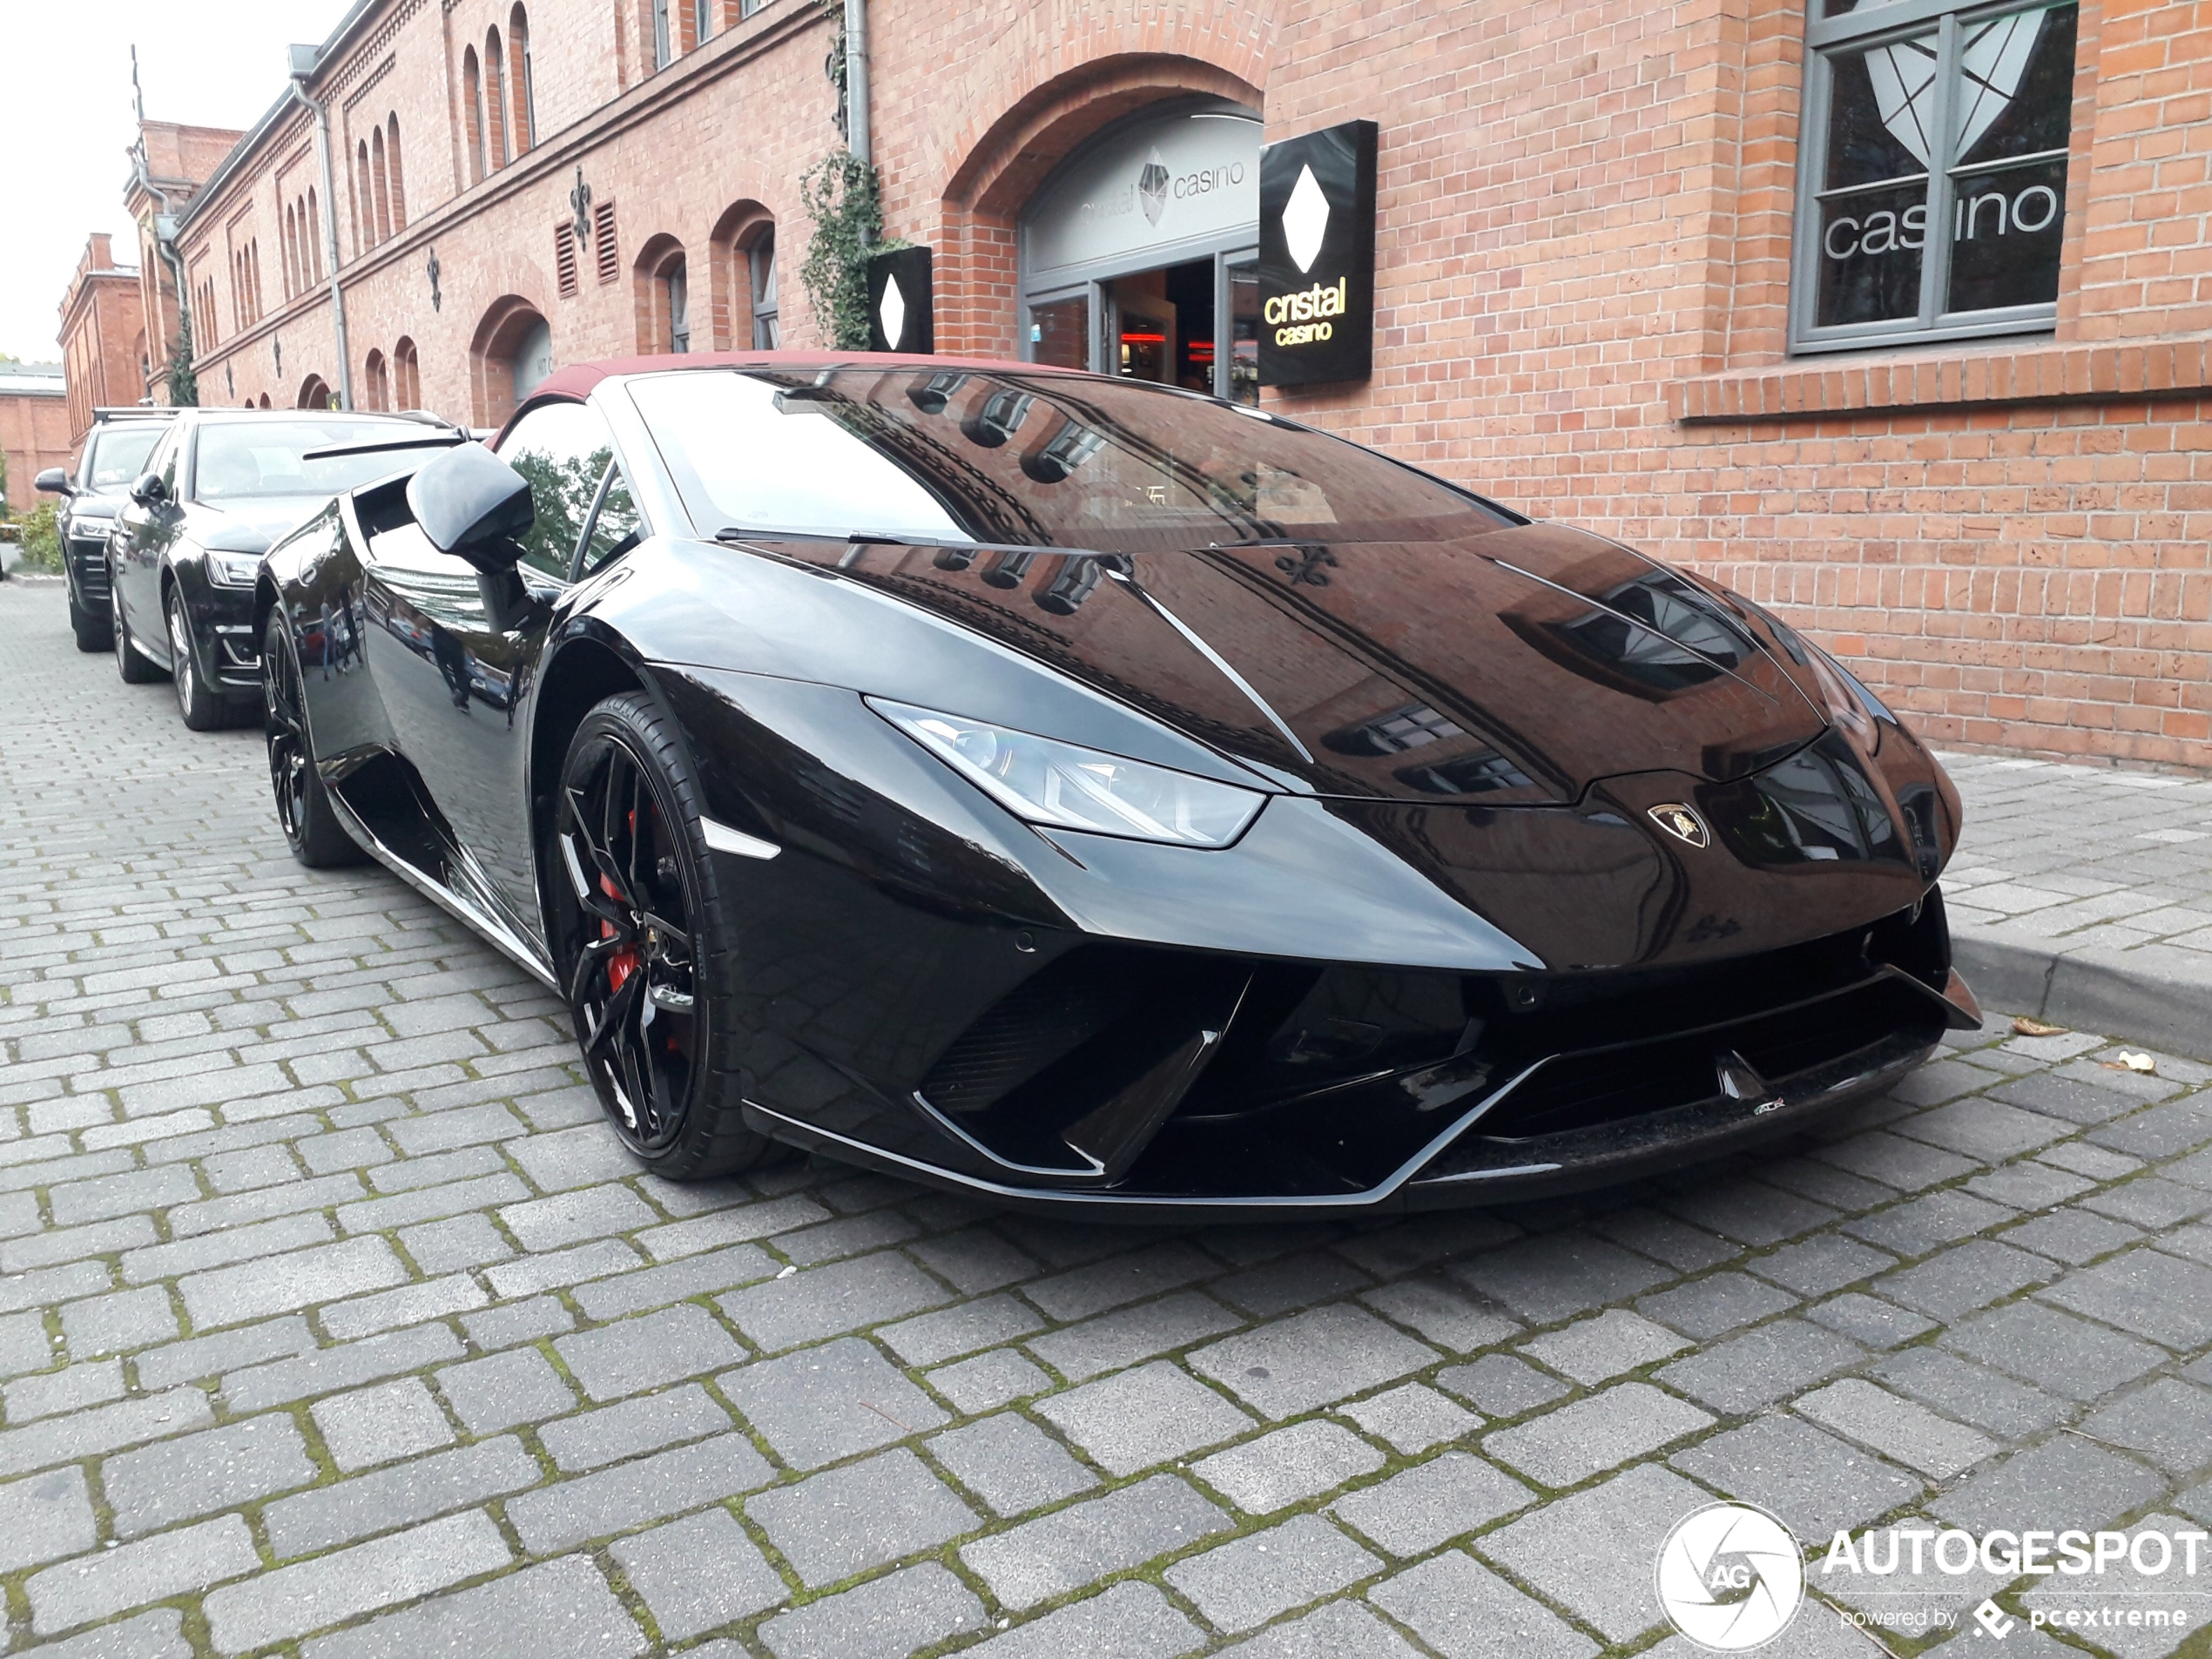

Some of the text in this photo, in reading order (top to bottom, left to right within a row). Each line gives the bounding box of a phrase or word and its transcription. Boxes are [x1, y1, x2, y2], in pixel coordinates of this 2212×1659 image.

[1174, 162, 1244, 199] casino
[1824, 185, 2057, 260] casino
[1264, 276, 1346, 325] cristal
[1275, 321, 1332, 347] casino
